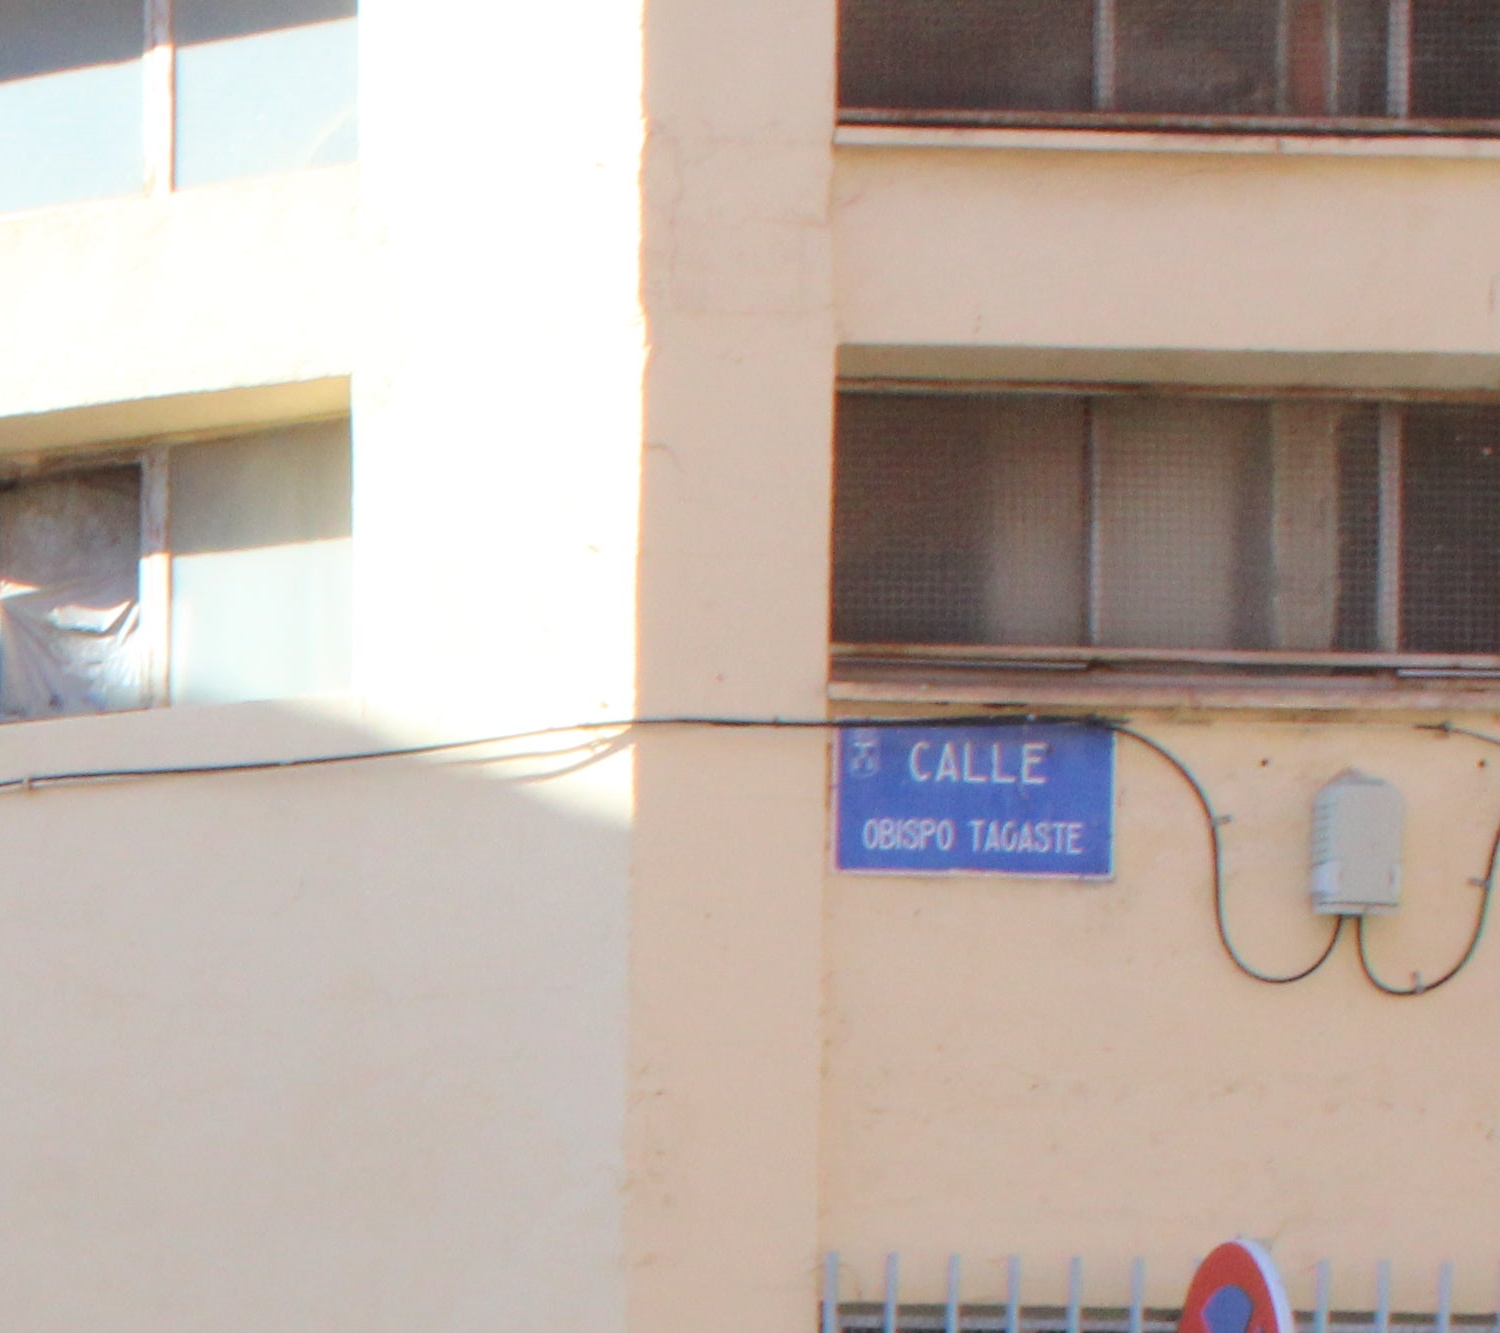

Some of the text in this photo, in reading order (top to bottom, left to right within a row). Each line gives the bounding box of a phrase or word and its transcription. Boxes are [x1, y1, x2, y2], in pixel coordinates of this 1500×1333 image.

[908, 740, 1049, 786] CALLE
[861, 817, 1084, 855] OBISPO TAGASTE
